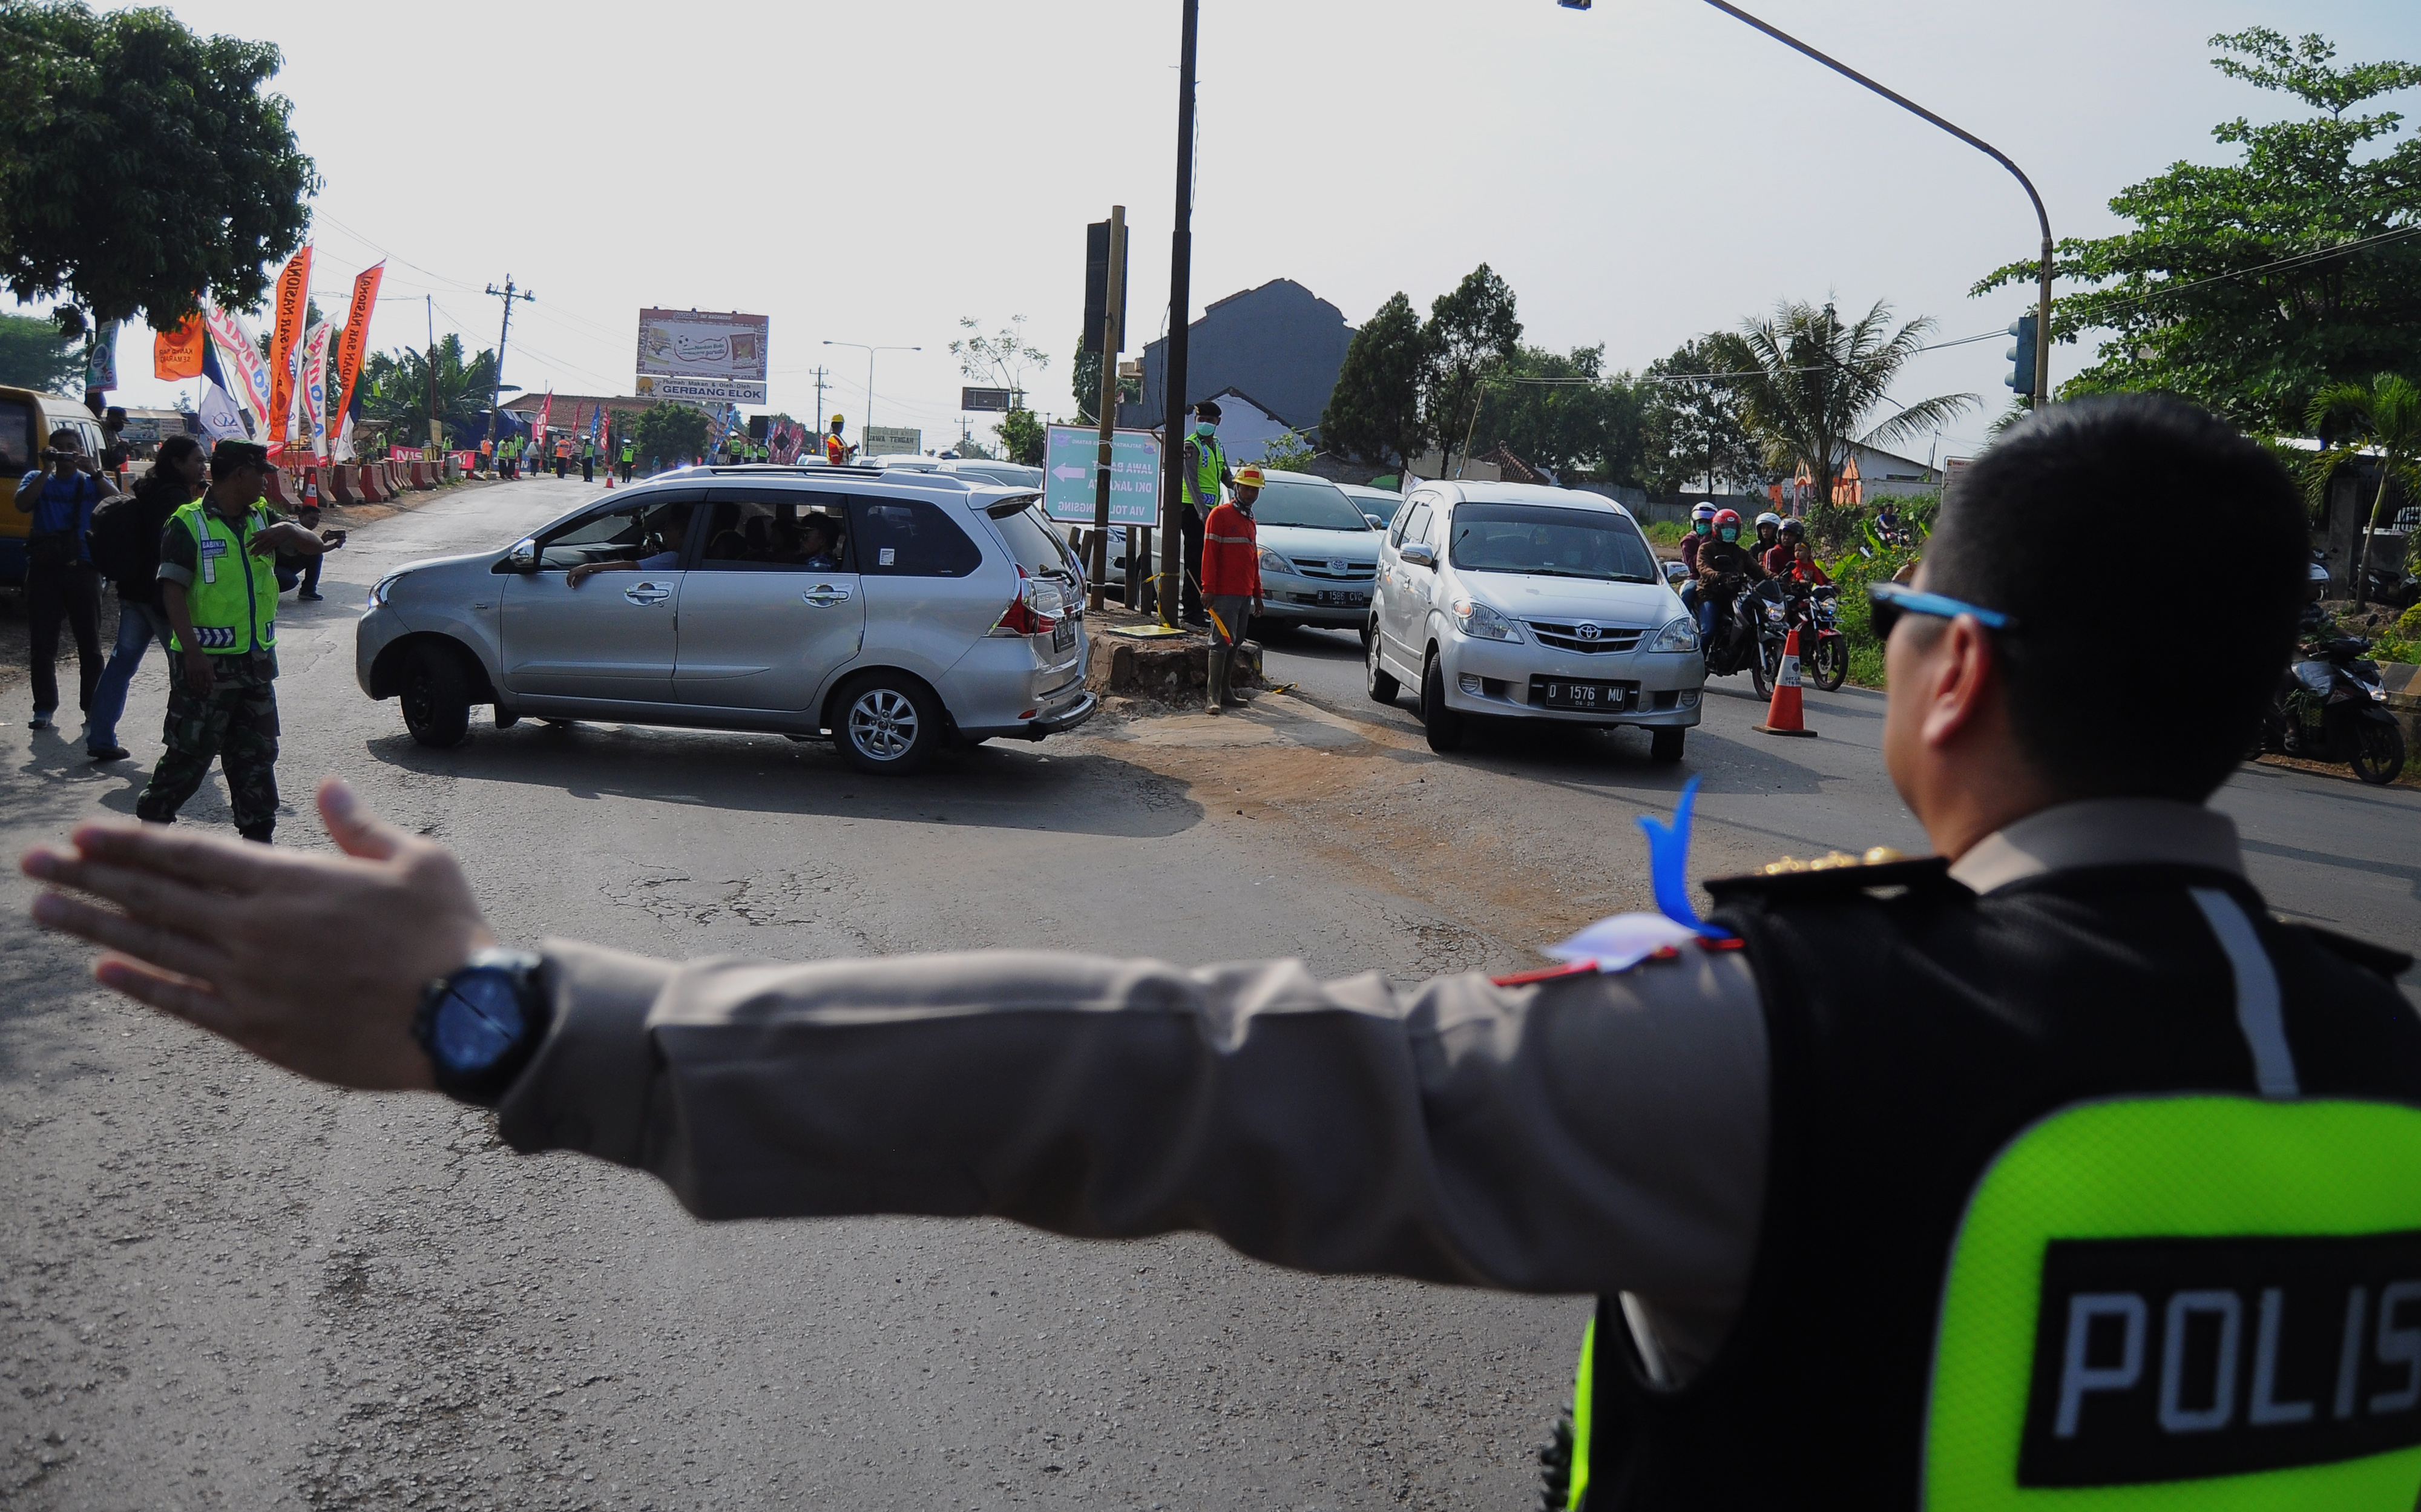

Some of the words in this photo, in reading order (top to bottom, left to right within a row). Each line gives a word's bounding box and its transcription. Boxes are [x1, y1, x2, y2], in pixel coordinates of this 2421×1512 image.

[663, 386, 725, 396] GERBANG
[729, 389, 761, 398] ELOK
[1318, 591, 1323, 600] B
[1330, 591, 1345, 600] 1586
[1549, 685, 1556, 698] D
[1570, 686, 1595, 700] 1576
[1608, 688, 1623, 702] MU
